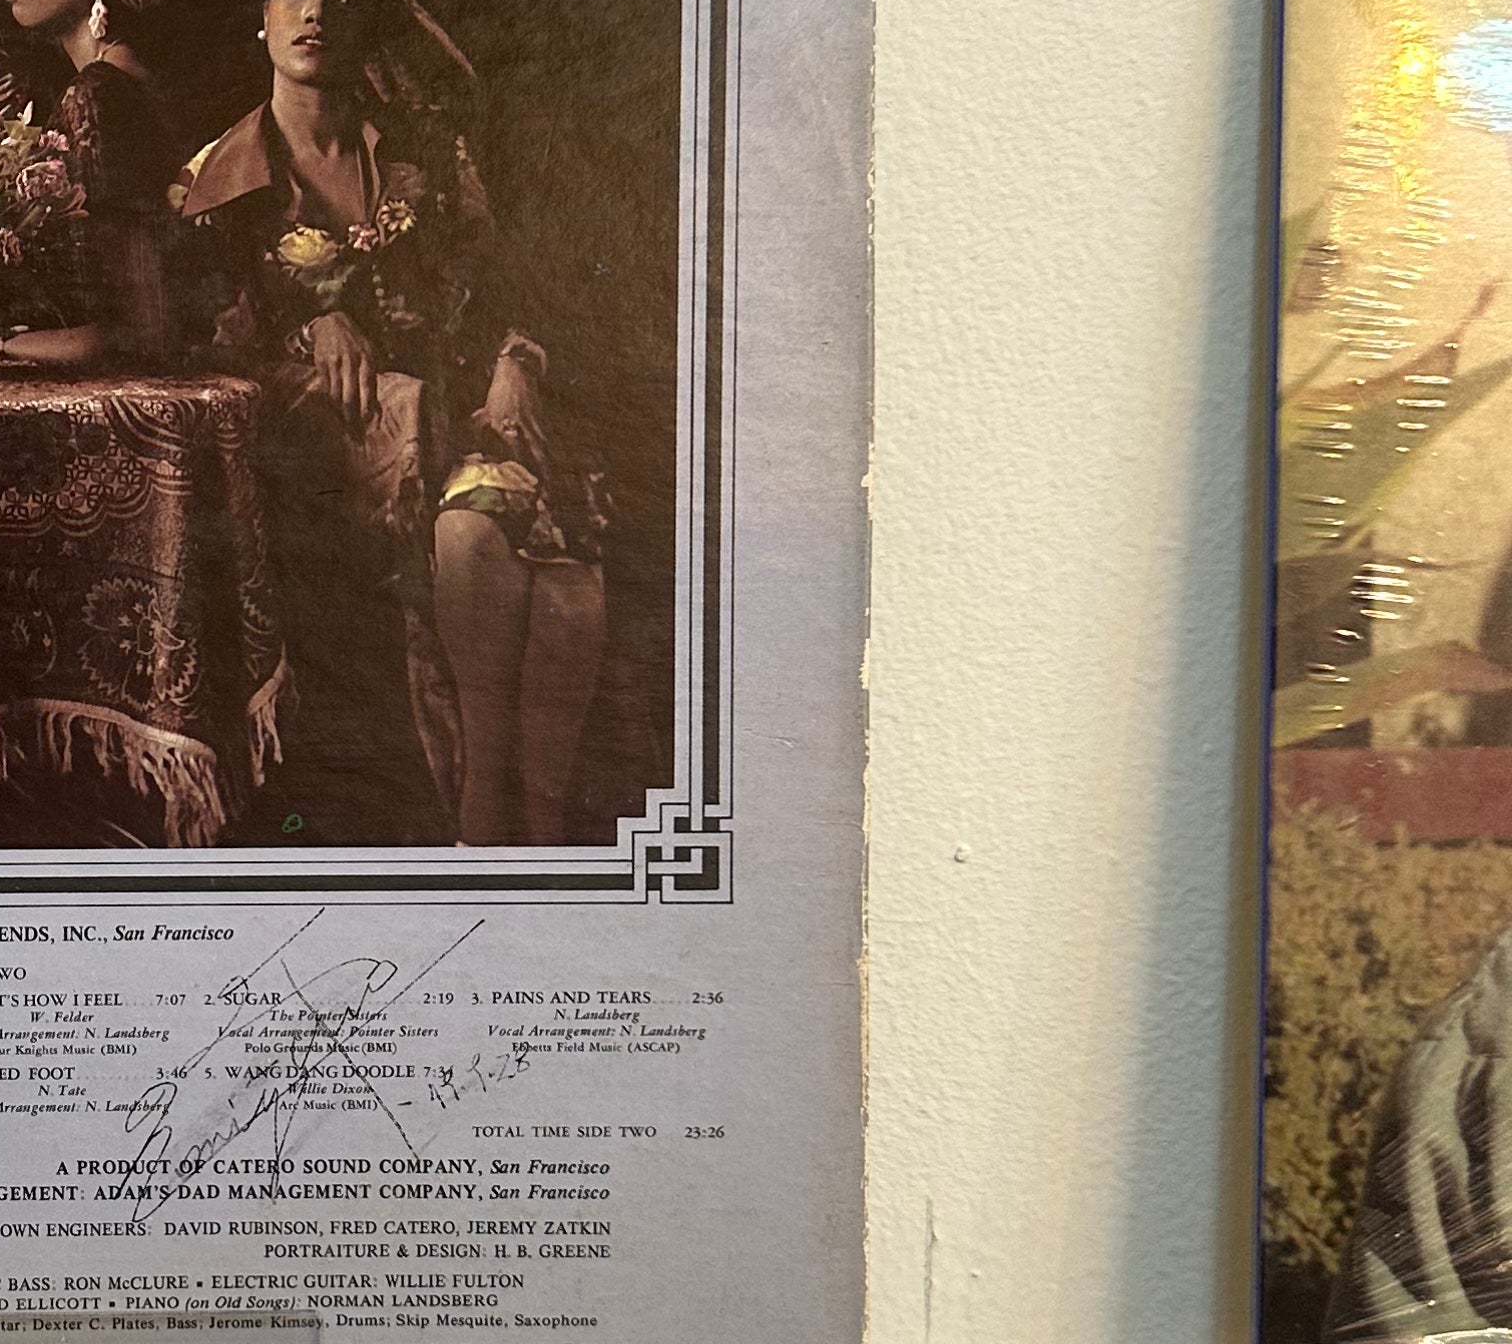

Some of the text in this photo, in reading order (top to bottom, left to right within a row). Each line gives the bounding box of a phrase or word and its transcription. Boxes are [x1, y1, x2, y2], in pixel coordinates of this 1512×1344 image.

[63, 926, 107, 943] INC.,
[113, 925, 144, 941] San
[151, 925, 234, 940] Francisco
[23, 994, 67, 1007] HOW
[73, 994, 78, 1006] I
[84, 994, 123, 1006] FEEL
[156, 994, 186, 1005] 7:07
[204, 993, 454, 1005] 2. SUGAR 2:19
[472, 991, 723, 1005] 3. PAINS AND TEARS 2:36
[16, 1045, 57, 1057] Knights
[63, 1045, 95, 1054] Music
[101, 1045, 137, 1056] (BMI)
[29, 1067, 75, 1080] FOOT
[156, 1068, 187, 1079] 3:46
[472, 1126, 724, 1139] TOTAL TIME SIDE TWO 23:26
[56, 1159, 610, 1176] A PRODUCT OF CATERO SOUND COMPANY, San Francisco
[93, 1184, 173, 1202] ADAM'S
[177, 1184, 221, 1201] DAD
[228, 1183, 372, 1201] MANAGEMENT
[379, 1184, 482, 1201] COMPANY,
[490, 1185, 520, 1199] San
[528, 1185, 610, 1199] Francisco
[264, 1244, 610, 1258] PORTRAITURE & DESIGN: H. B. GREENE
